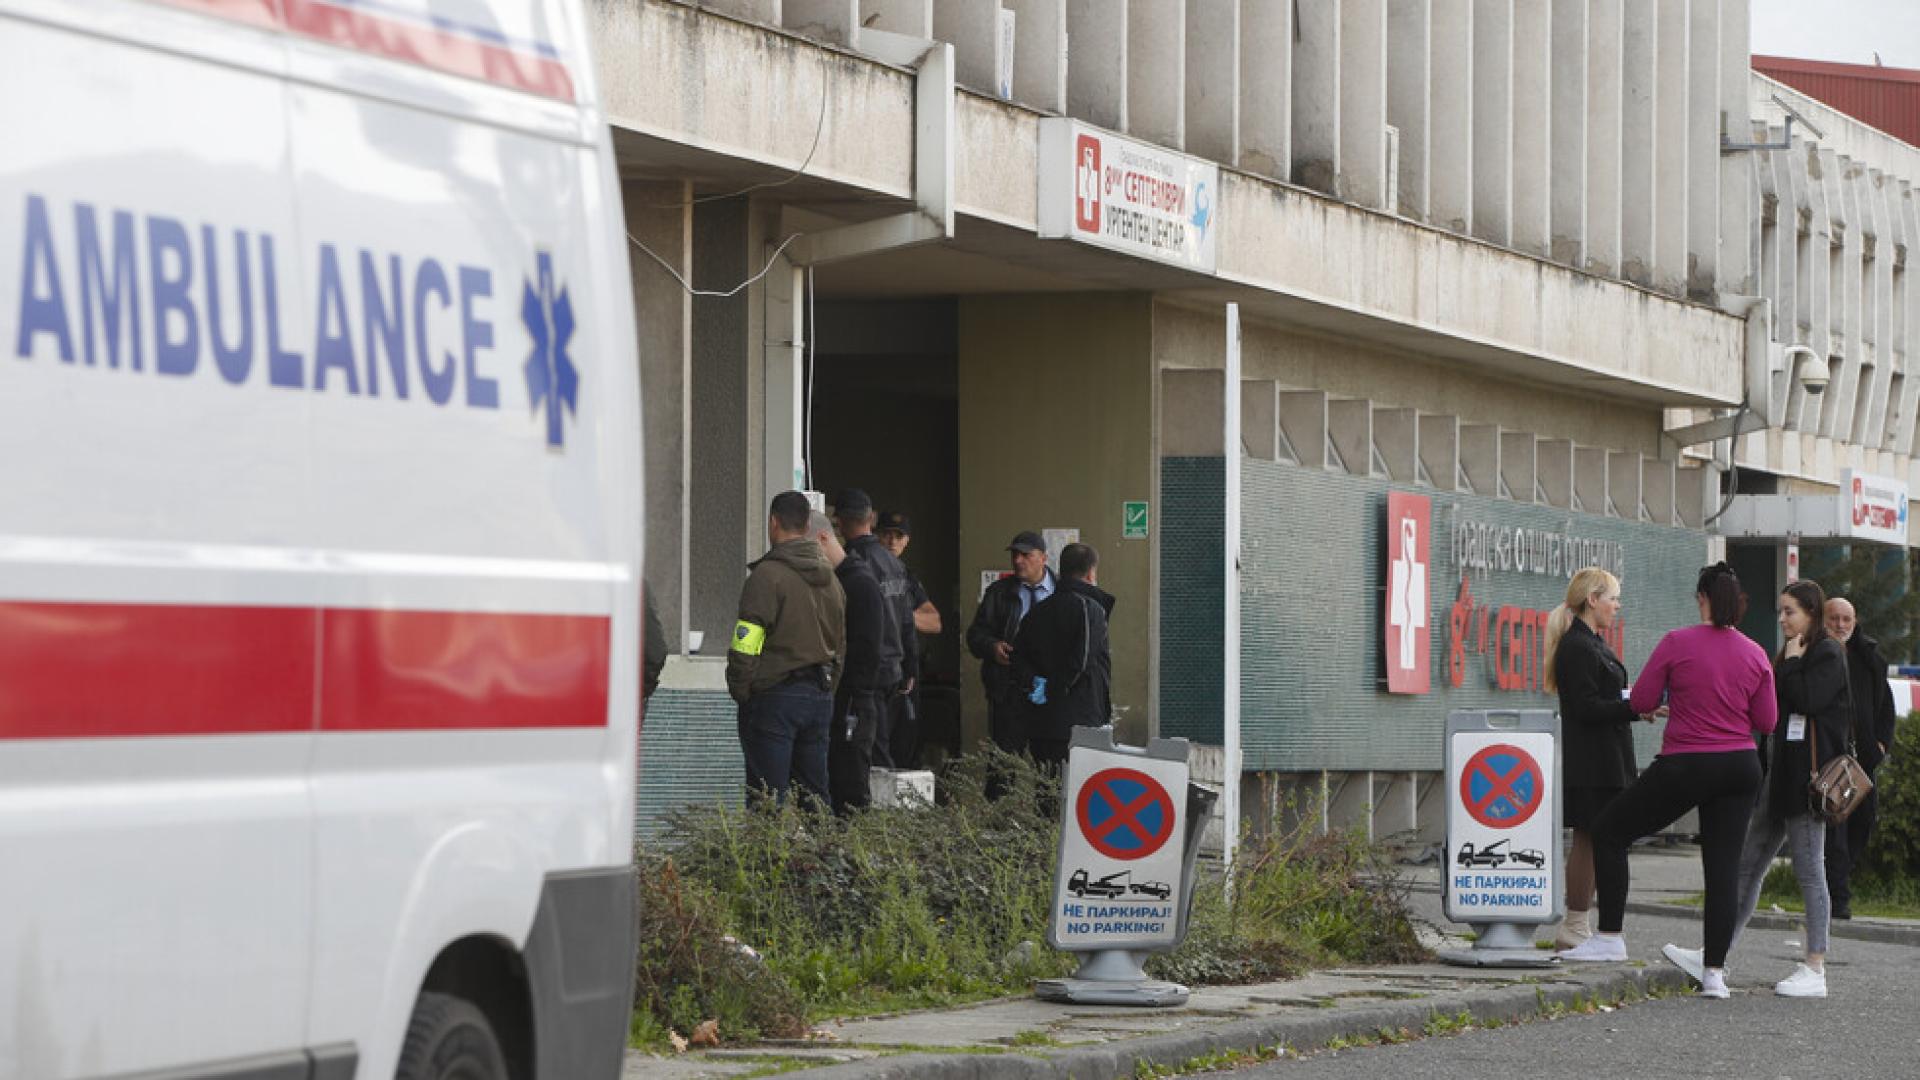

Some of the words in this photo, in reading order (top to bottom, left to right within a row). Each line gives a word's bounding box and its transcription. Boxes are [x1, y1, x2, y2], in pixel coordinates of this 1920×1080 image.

[1125, 170, 1186, 217] СЕПТЕМВРИ
[16, 193, 500, 410] AMBULANCE
[1455, 875, 1472, 888] НЕ
[1475, 875, 1546, 889] ПАРКИРАЈ!
[1460, 893, 1478, 906] NO
[1481, 893, 1543, 906] PARKING!
[1063, 903, 1084, 918] НЕ
[1087, 905, 1173, 919] ПАРКИРАЈ!
[1067, 922, 1090, 934] NO
[1094, 922, 1165, 934] PARKING!
